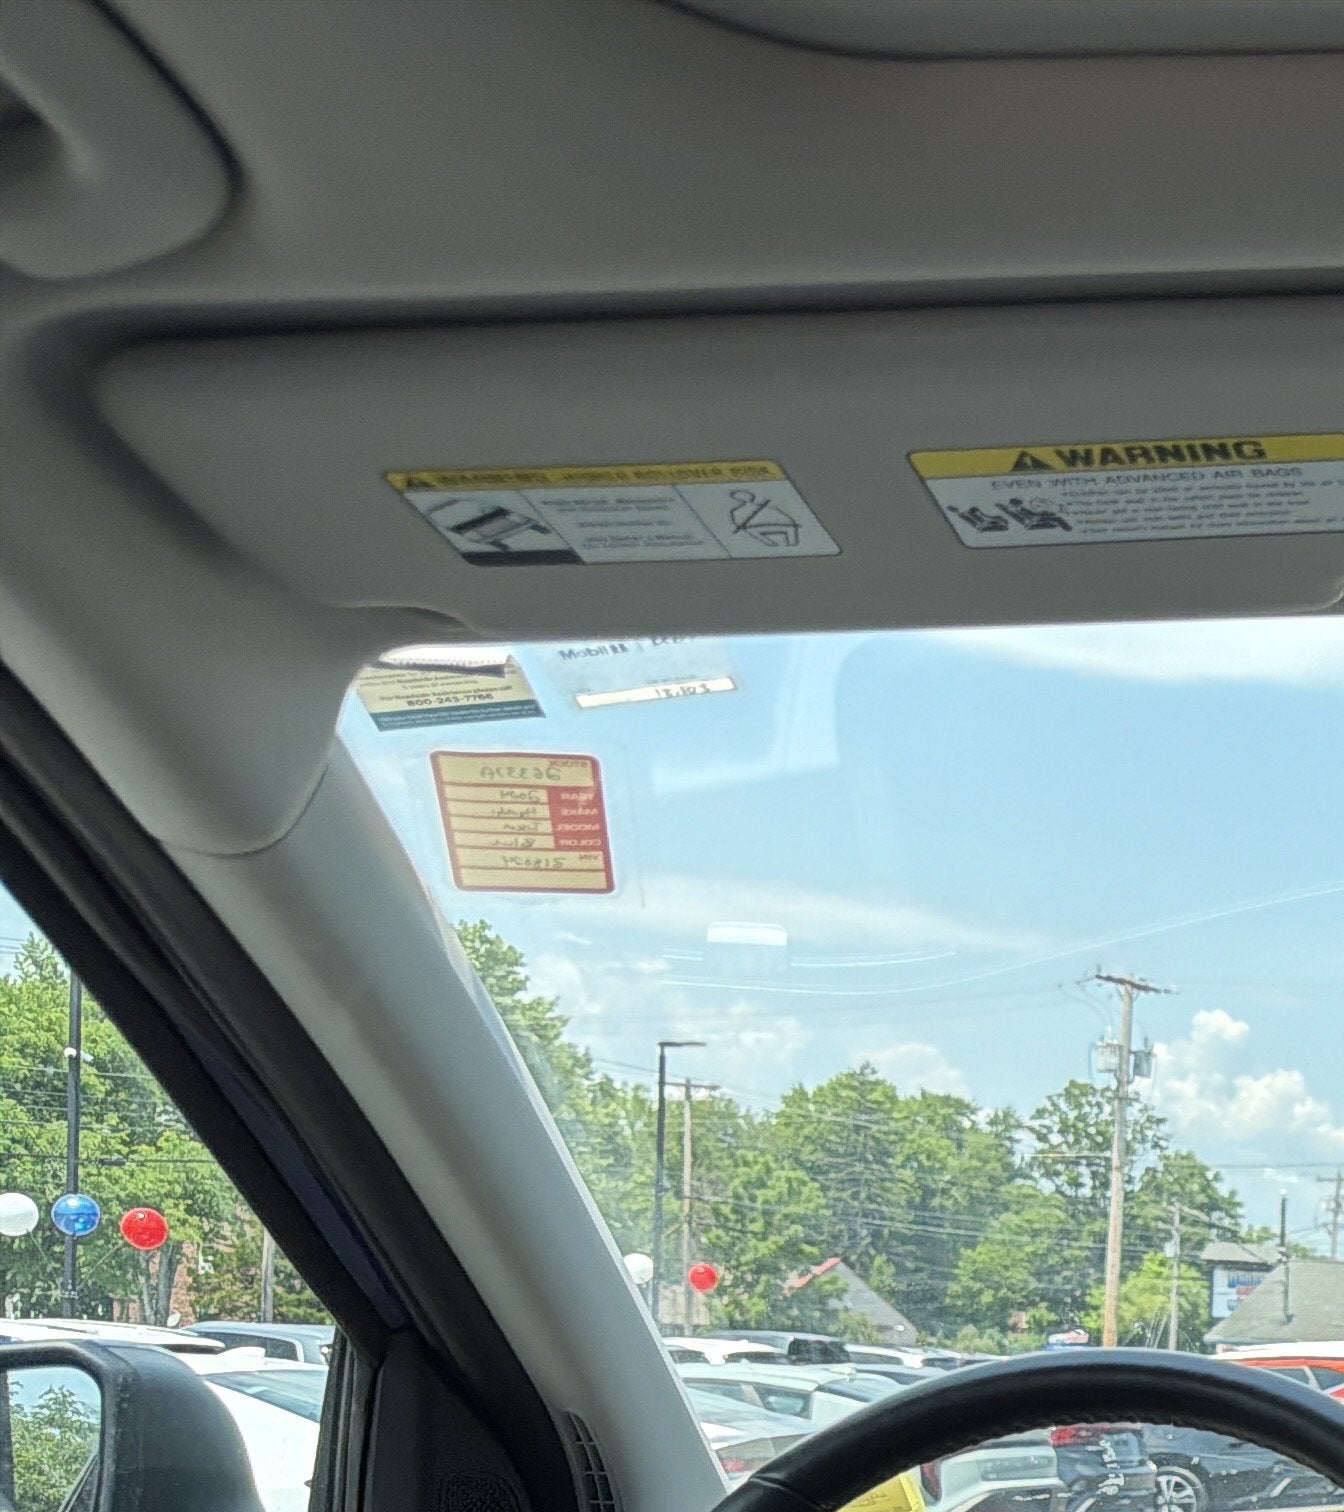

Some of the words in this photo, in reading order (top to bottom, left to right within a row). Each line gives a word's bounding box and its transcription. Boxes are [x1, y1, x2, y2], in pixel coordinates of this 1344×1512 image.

[1055, 440, 1268, 468] WARNING
[992, 479, 1041, 490] EVEN
[1049, 475, 1097, 488] WITH
[1213, 468, 1244, 480] AIR
[1251, 466, 1303, 479] BAGS
[558, 645, 608, 660] Mobil
